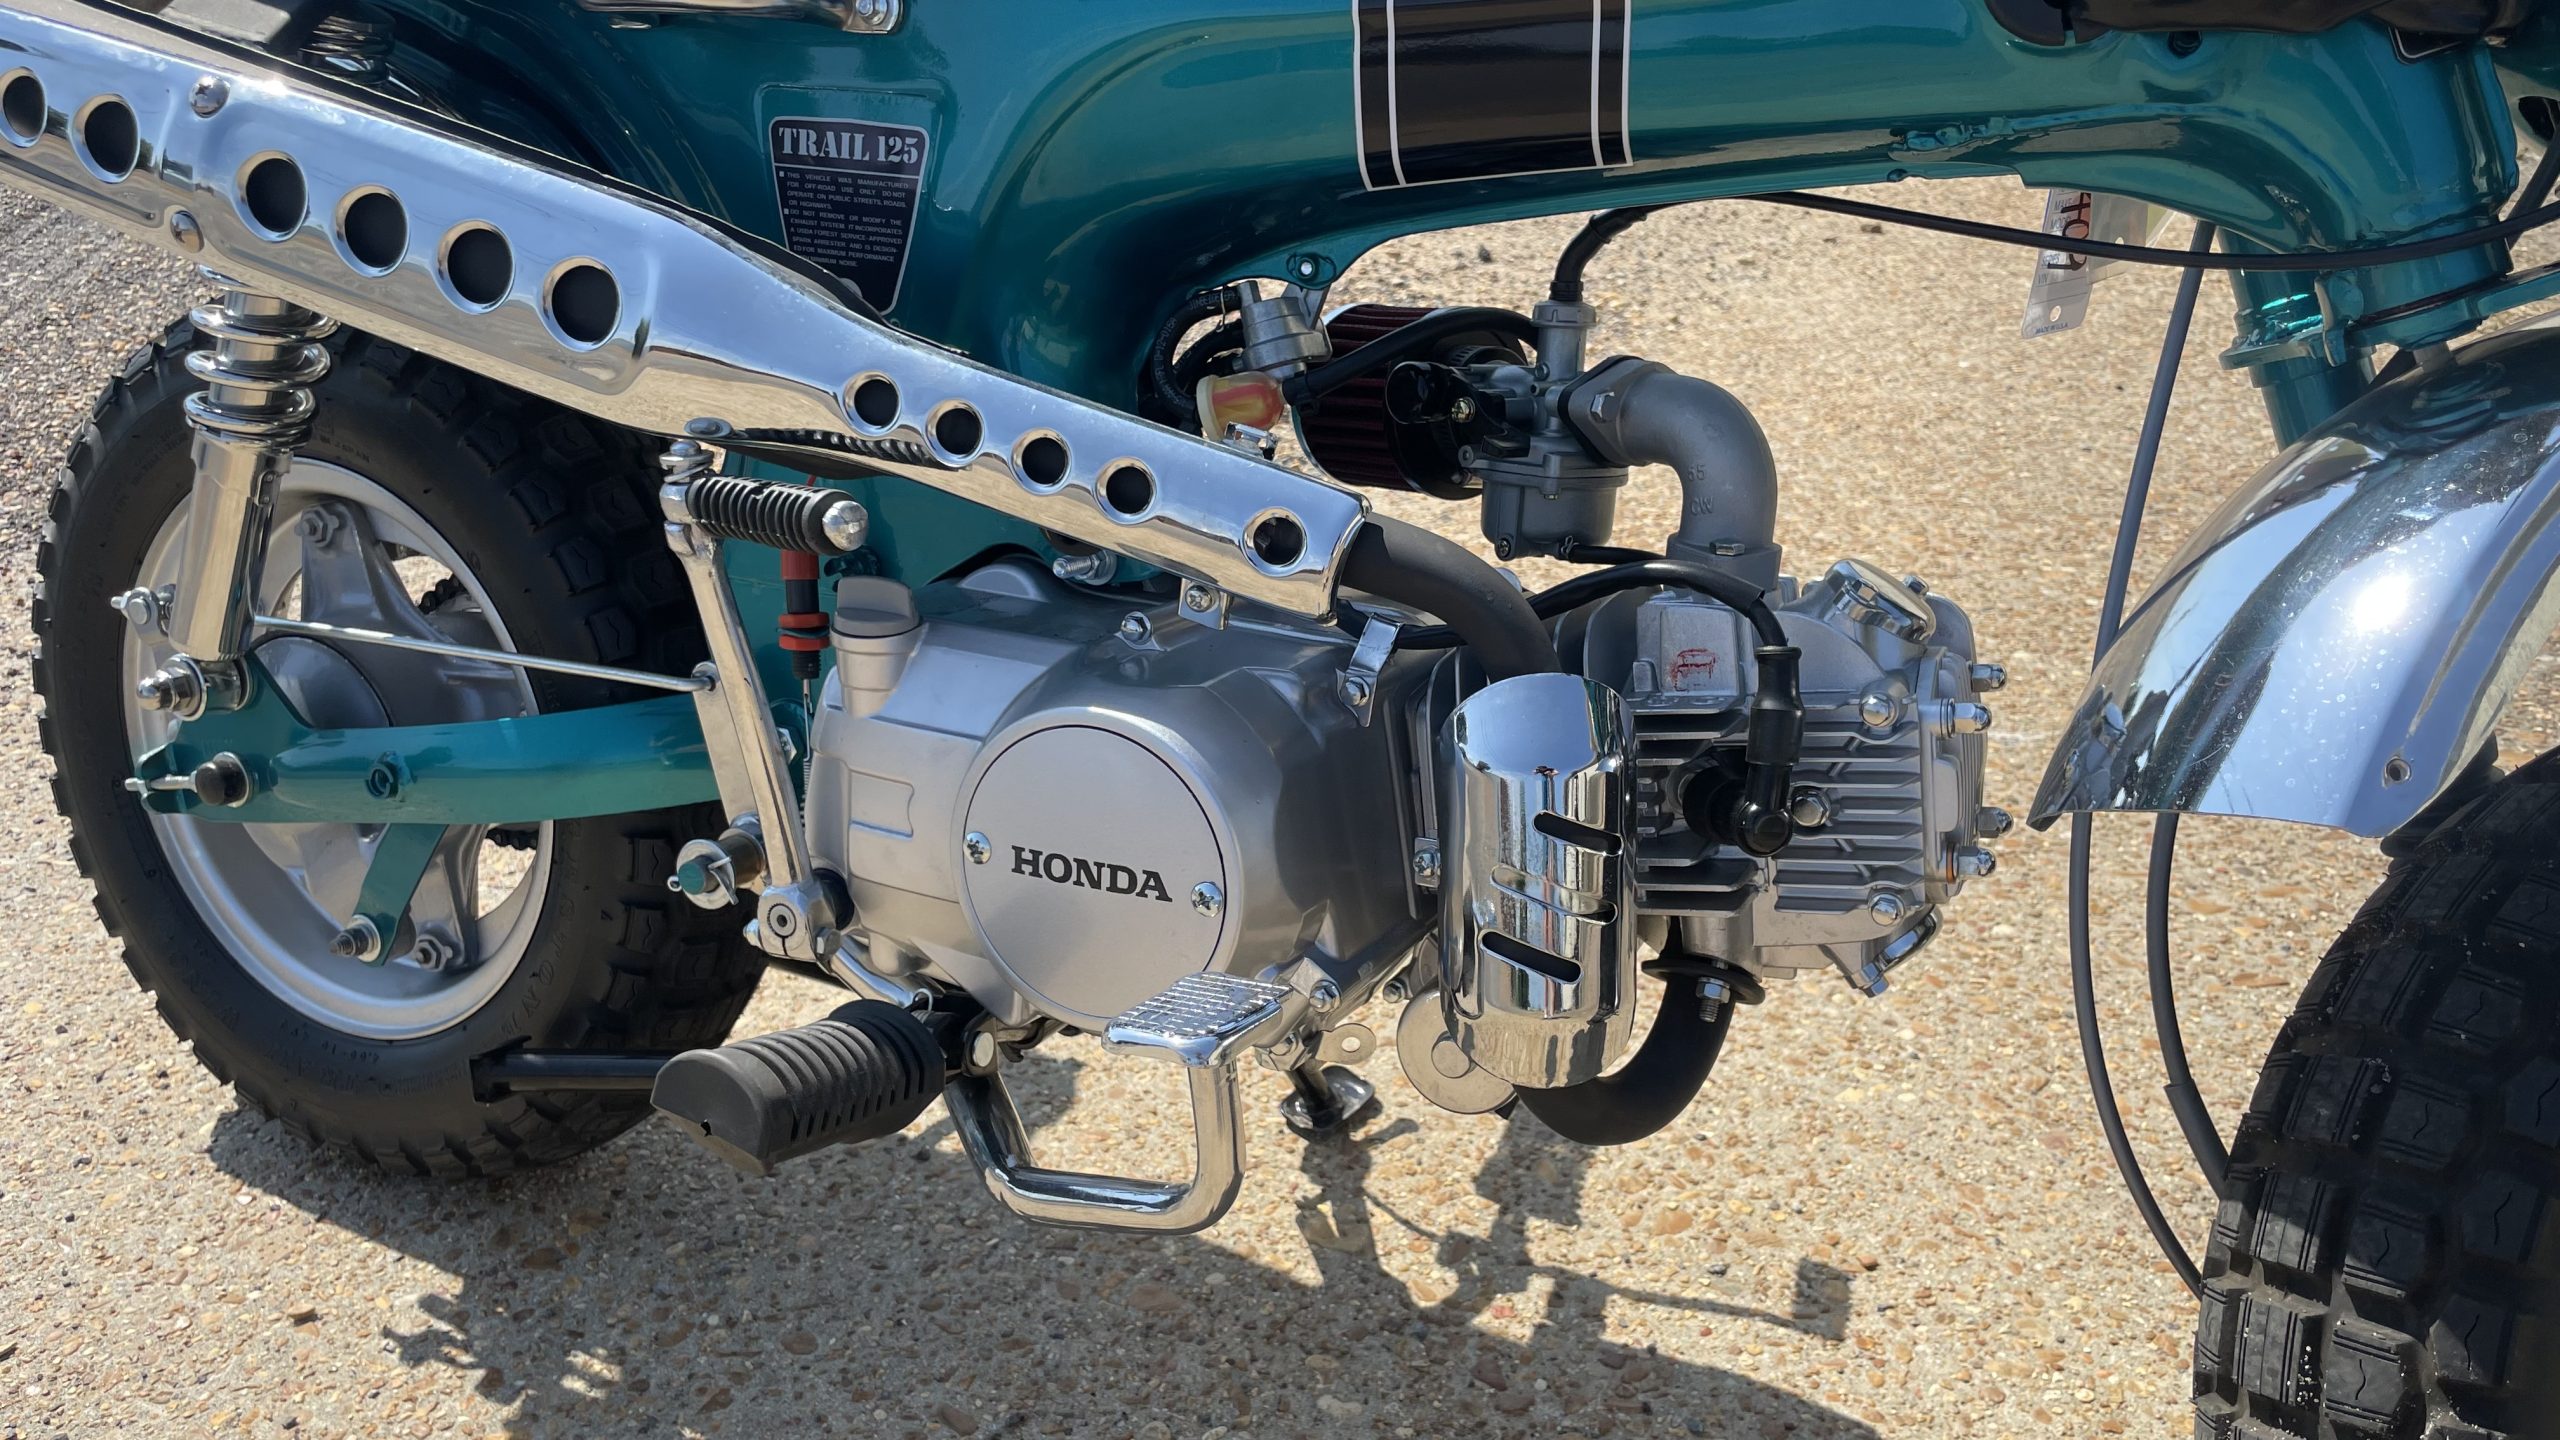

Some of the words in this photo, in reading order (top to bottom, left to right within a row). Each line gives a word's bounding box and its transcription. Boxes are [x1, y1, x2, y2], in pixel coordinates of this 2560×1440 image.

[779, 127, 870, 161] TRAIL
[877, 135, 919, 164] 125
[804, 173, 831, 182] VEHICLE
[838, 176, 852, 184] WAS
[857, 178, 909, 190] MANUFACTURED
[786, 190, 814, 199] OPERATE
[828, 194, 851, 203] PUBLIC
[841, 186, 854, 194] USE
[892, 191, 906, 199] NOT
[819, 211, 846, 220] REMOVE
[862, 216, 886, 225] MODIFY
[890, 218, 903, 226] THE
[790, 217, 817, 226] EXHAUST
[854, 225, 903, 236] INCORPORATES
[814, 229, 839, 238] FOREST
[792, 235, 812, 244] SPARK
[849, 242, 863, 250] AND
[817, 247, 847, 257] MAXIMUM
[848, 251, 895, 263] PERFORMANCE
[1012, 845, 1173, 902] HONDA
